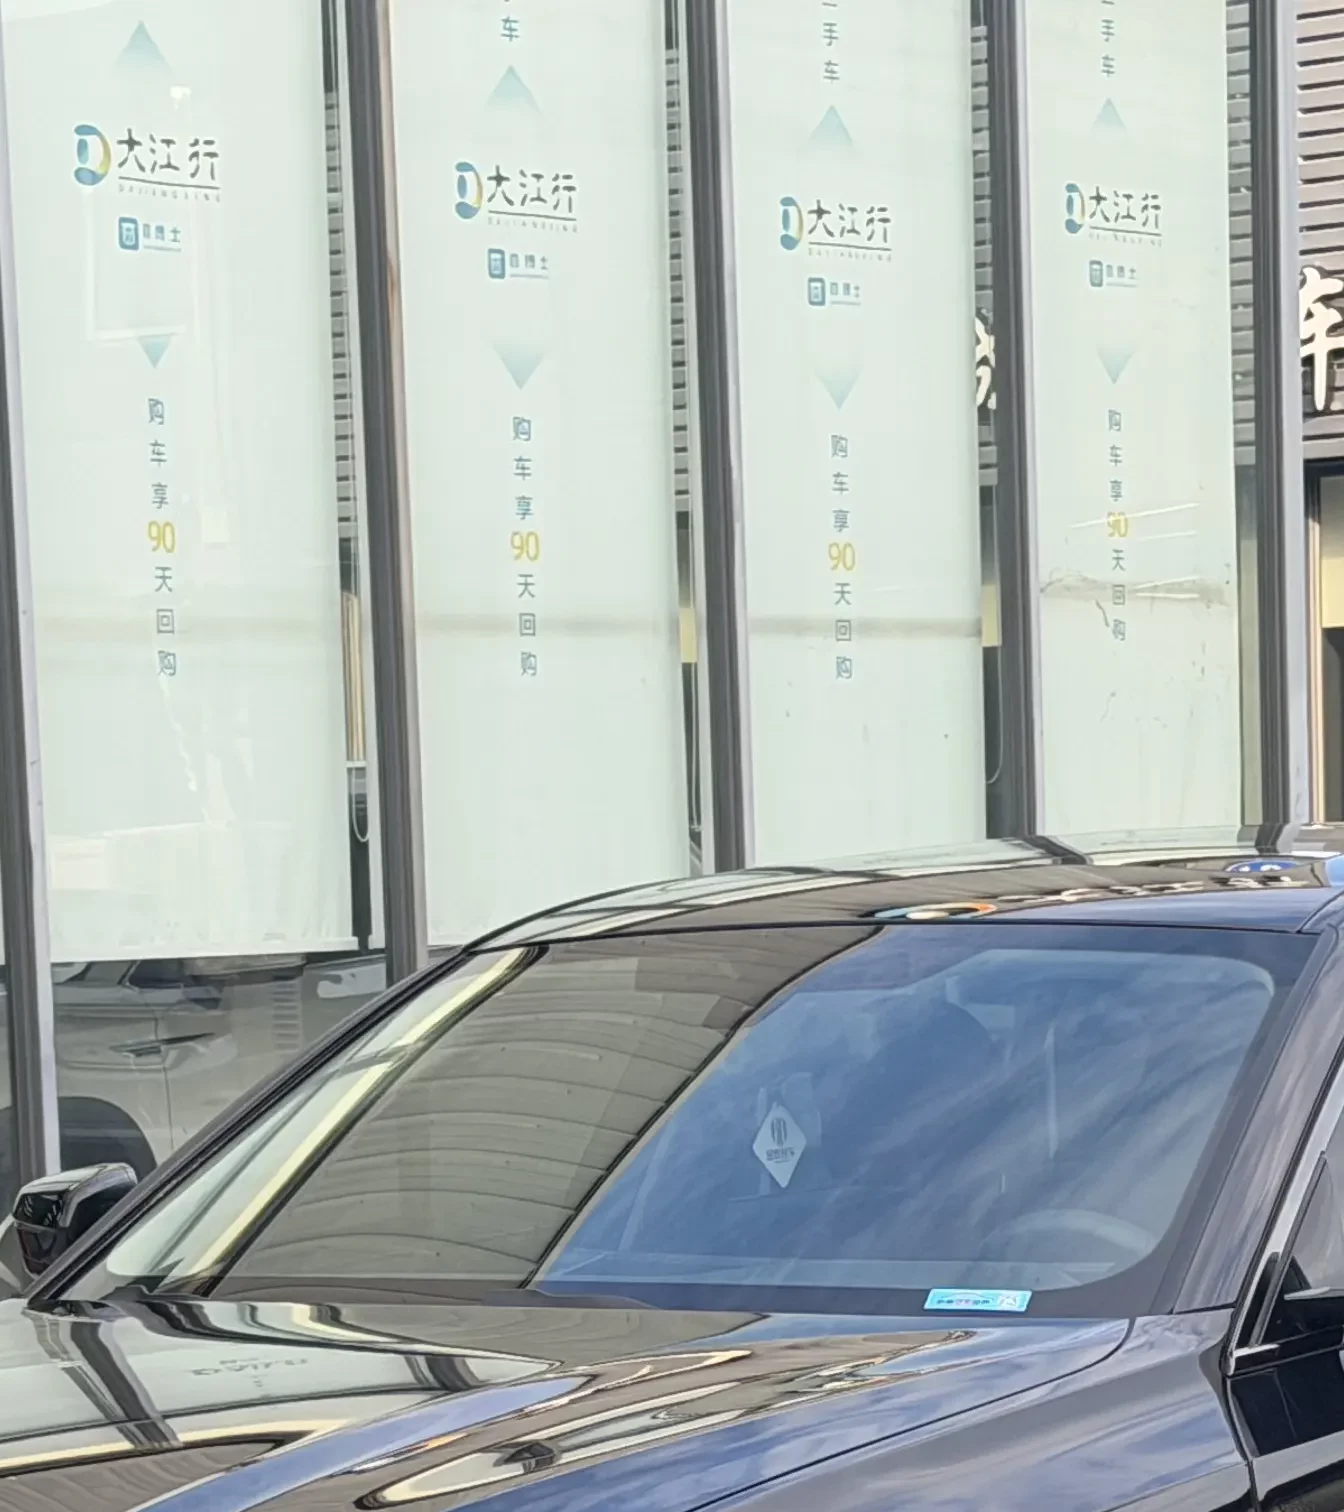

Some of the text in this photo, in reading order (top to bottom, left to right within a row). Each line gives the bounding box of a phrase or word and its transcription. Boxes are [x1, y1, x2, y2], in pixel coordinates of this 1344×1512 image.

[117, 128, 219, 181] 大江行
[487, 165, 576, 213] 大江行
[1088, 186, 1162, 229] 大江行
[807, 199, 891, 243] 大江行
